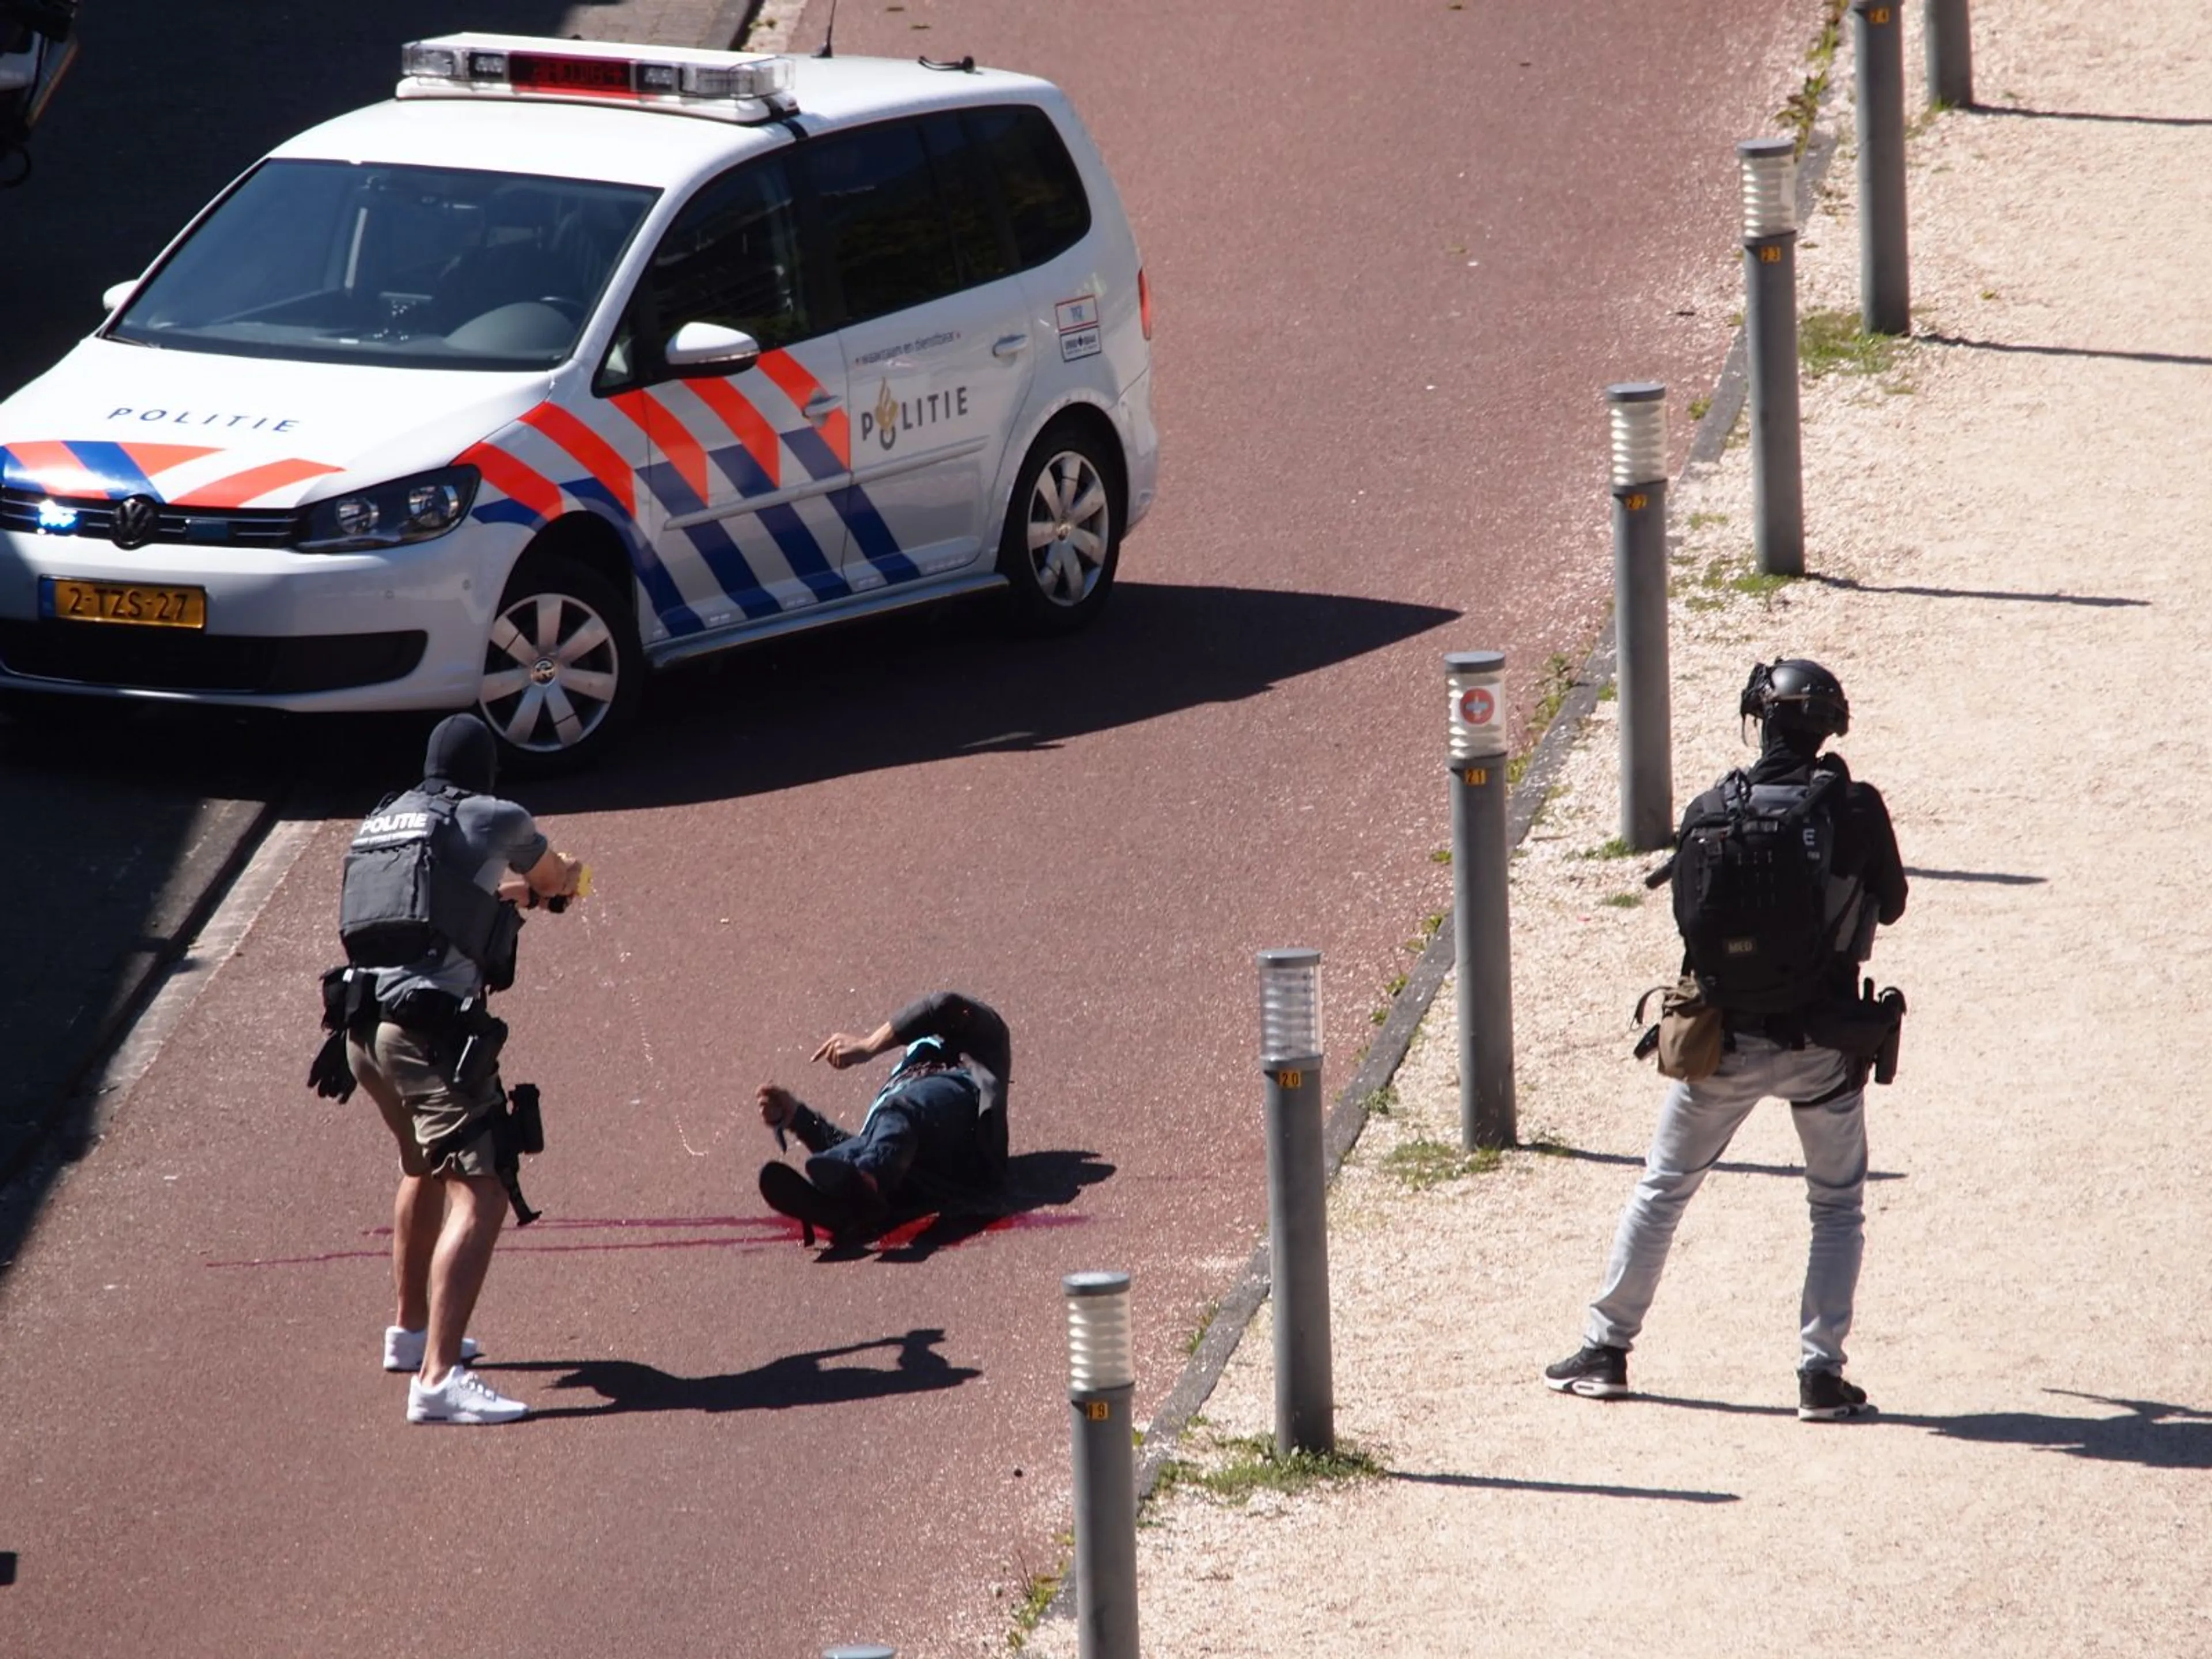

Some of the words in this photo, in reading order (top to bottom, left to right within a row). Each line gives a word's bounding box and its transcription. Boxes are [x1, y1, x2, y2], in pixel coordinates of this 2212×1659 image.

[107, 407, 300, 432] POLITIE
[861, 385, 968, 451] POLITIE
[69, 586, 189, 621] 2-TZS-27
[359, 812, 429, 836] POLITIE
[1282, 1072, 1299, 1087] 20
[1088, 1403, 1105, 1420] 19
